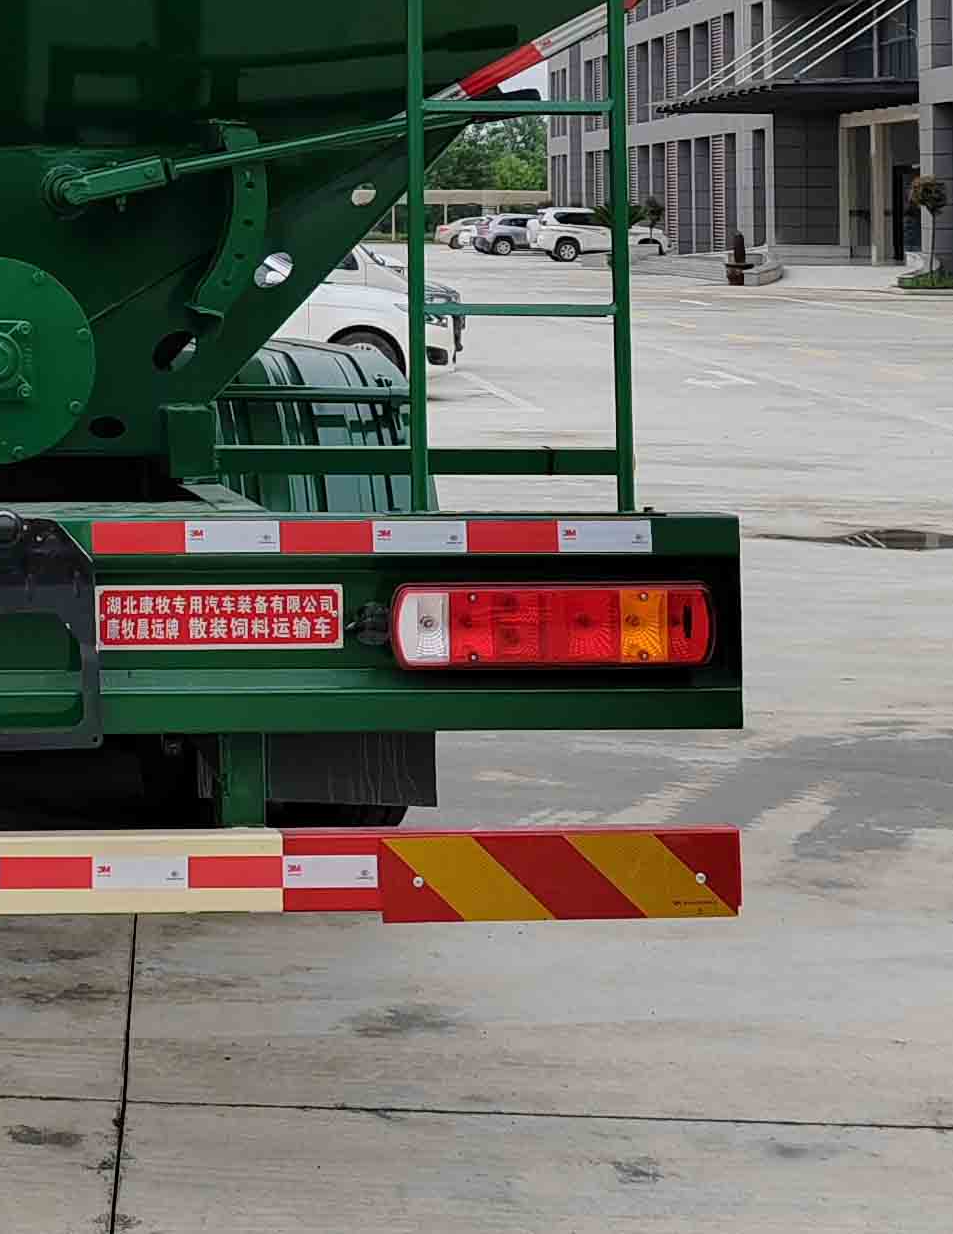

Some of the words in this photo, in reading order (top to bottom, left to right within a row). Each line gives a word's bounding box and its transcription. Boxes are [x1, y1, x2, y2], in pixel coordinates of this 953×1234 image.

[106, 595, 334, 615] 湖北康牧专用汽车装备有限公司
[188, 617, 332, 639] 散装饲料运输车
